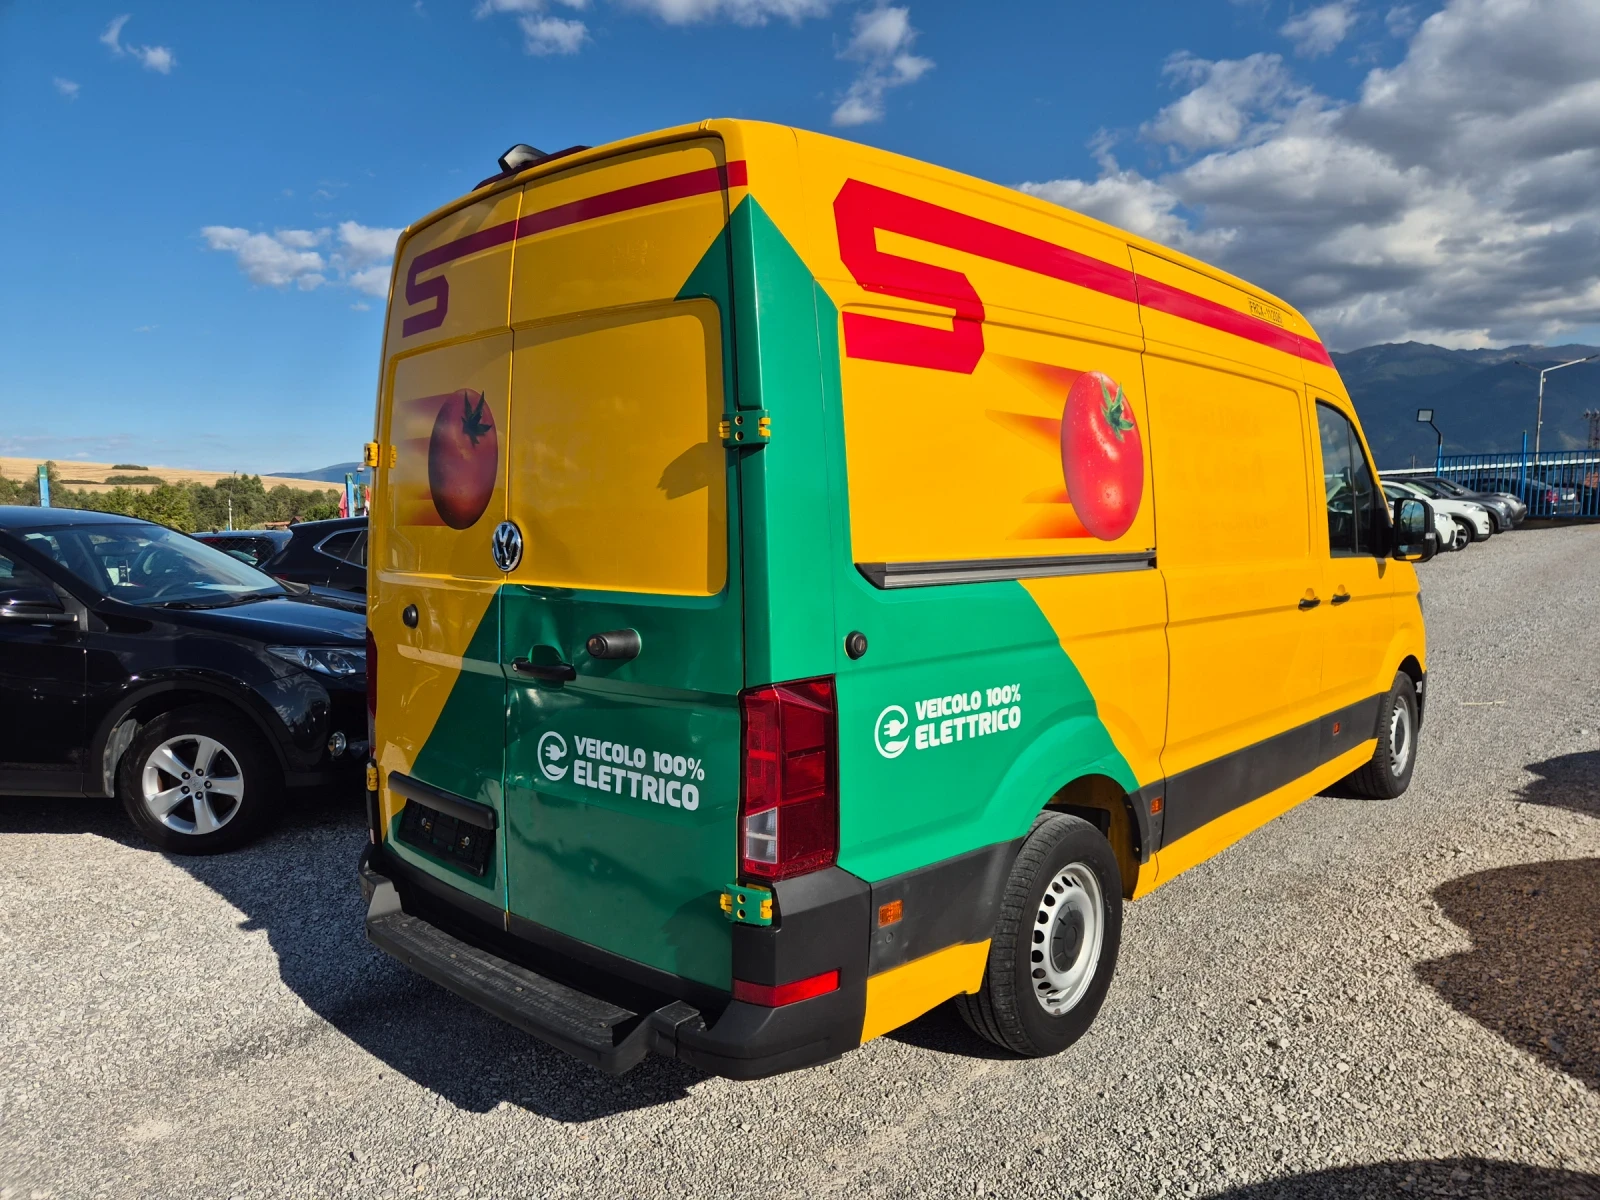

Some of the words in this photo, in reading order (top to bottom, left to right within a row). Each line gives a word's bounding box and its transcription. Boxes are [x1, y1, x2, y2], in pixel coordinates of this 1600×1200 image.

[915, 690, 982, 721] VEICOLO
[986, 683, 1021, 707] 100%
[915, 706, 1021, 750] ELETTRICO
[574, 735, 646, 769] VEICOLO
[653, 751, 705, 781] 100%
[574, 759, 700, 811] ELETTRICO
